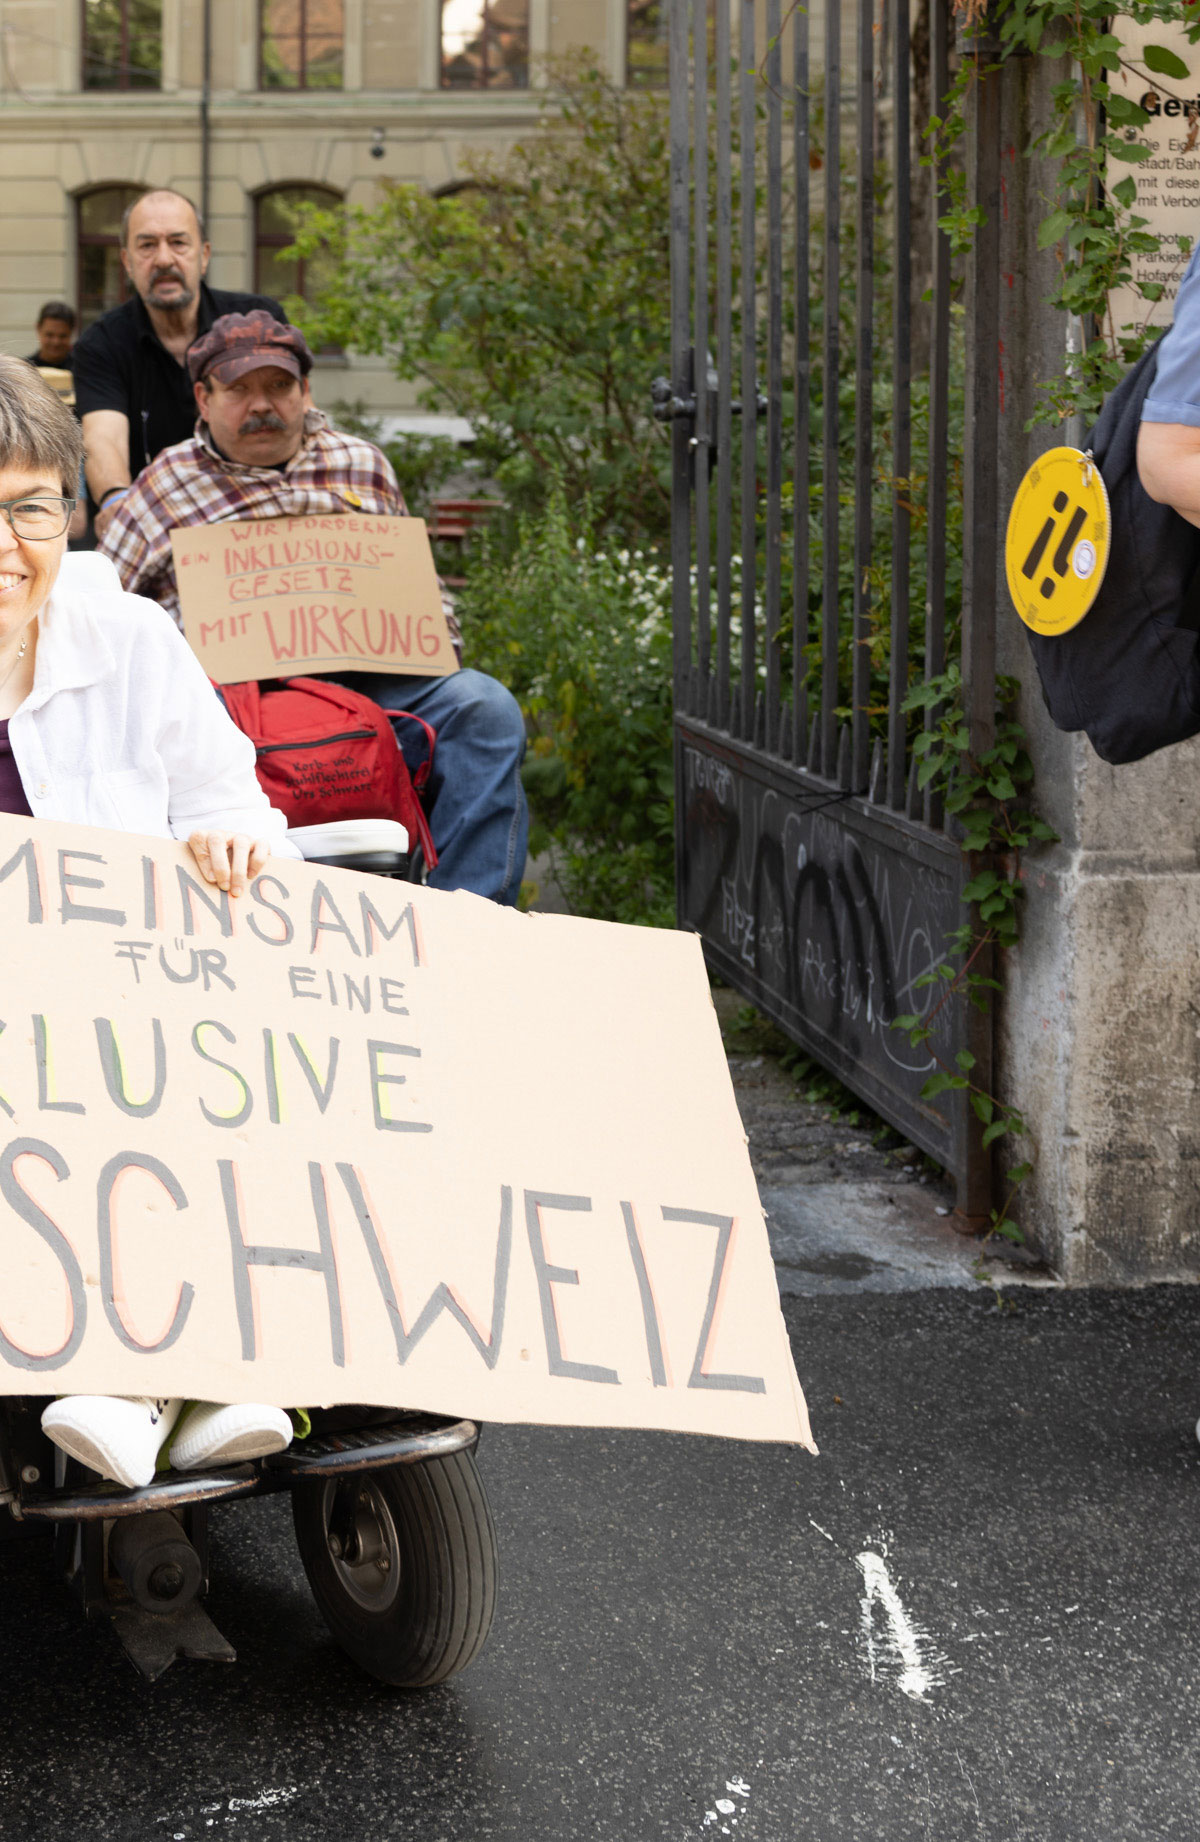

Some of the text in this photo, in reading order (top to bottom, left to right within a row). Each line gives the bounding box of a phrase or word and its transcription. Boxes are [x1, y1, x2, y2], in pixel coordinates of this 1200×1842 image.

[1138, 177, 1158, 188] mit
[1137, 195, 1158, 207] mit
[230, 520, 279, 542] WIR
[181, 539, 394, 578] EIN INKLUSIONS-
[228, 566, 353, 601] GESETZ
[199, 604, 440, 660] MIT WIRKUNG
[292, 759, 328, 772] Korb-
[292, 787, 314, 800] Urs
[115, 937, 410, 1016] FÜR EINE
